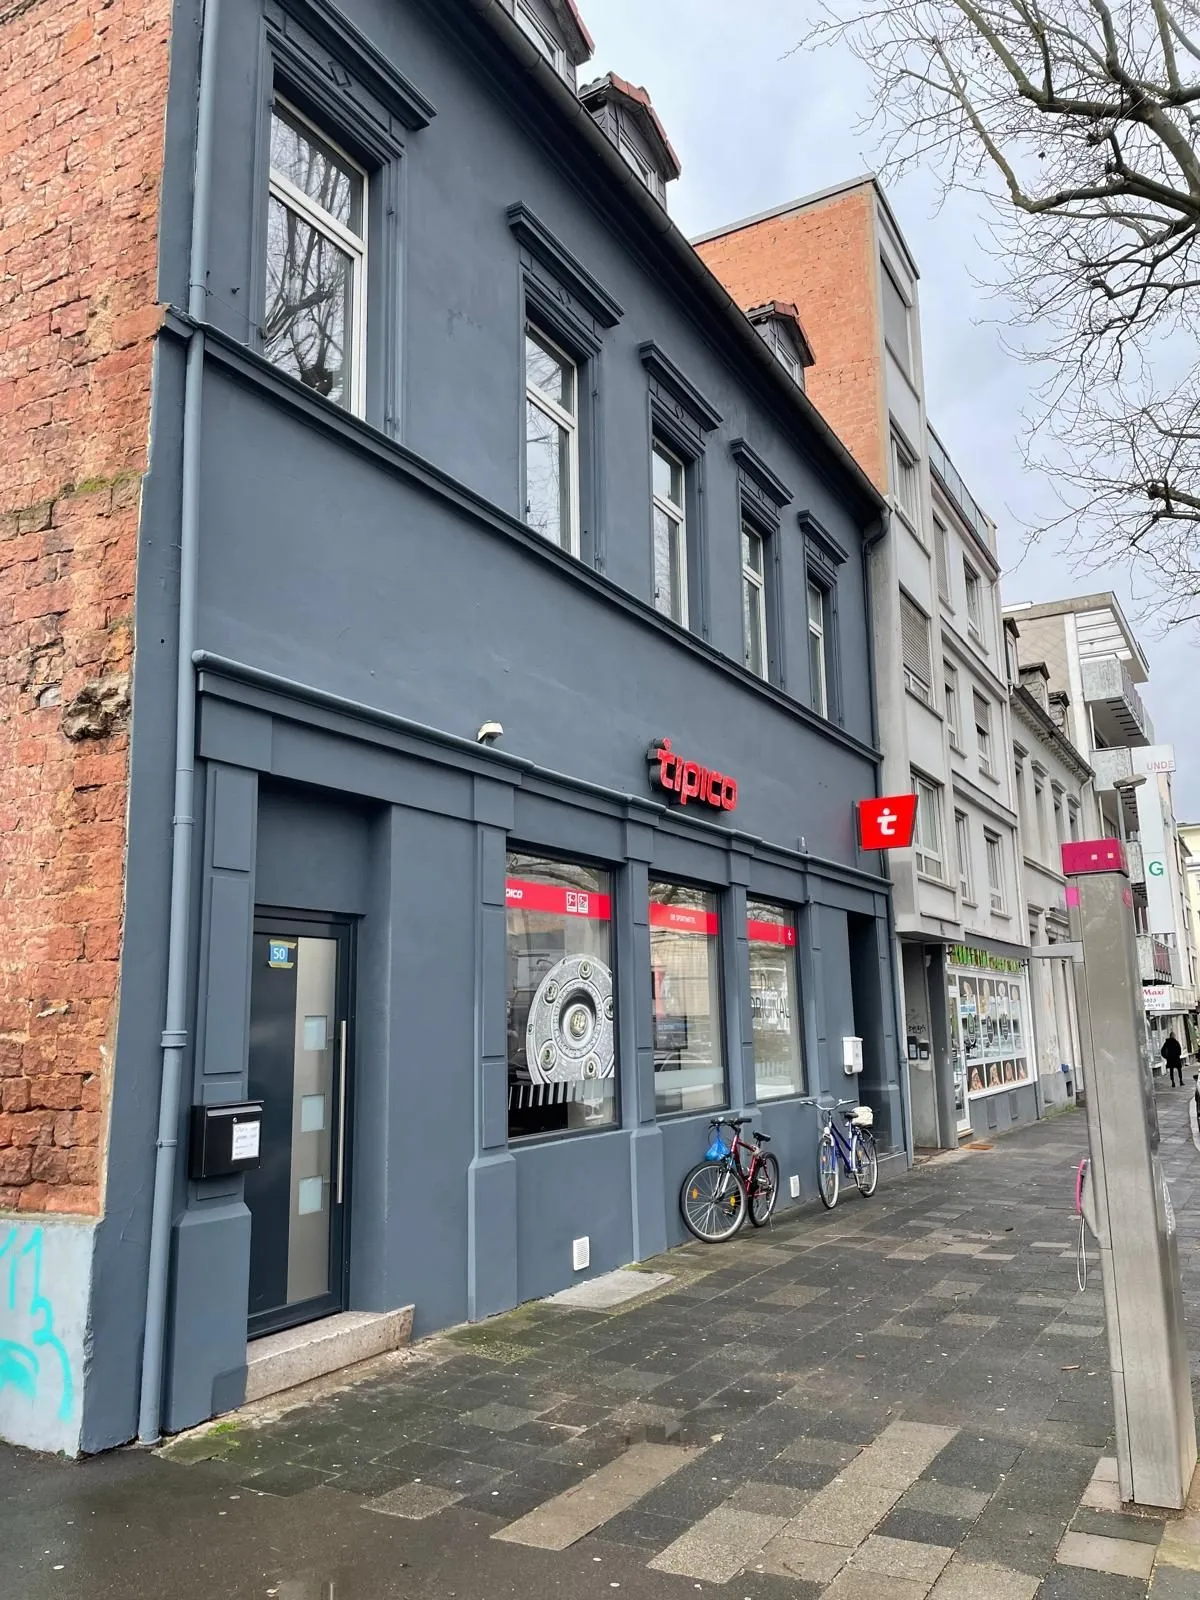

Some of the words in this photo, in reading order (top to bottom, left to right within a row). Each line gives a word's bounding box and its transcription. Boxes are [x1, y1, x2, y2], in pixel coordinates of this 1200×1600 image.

[657, 737, 737, 811] tipico
[1148, 861, 1164, 876] G
[273, 947, 286, 960] 50
